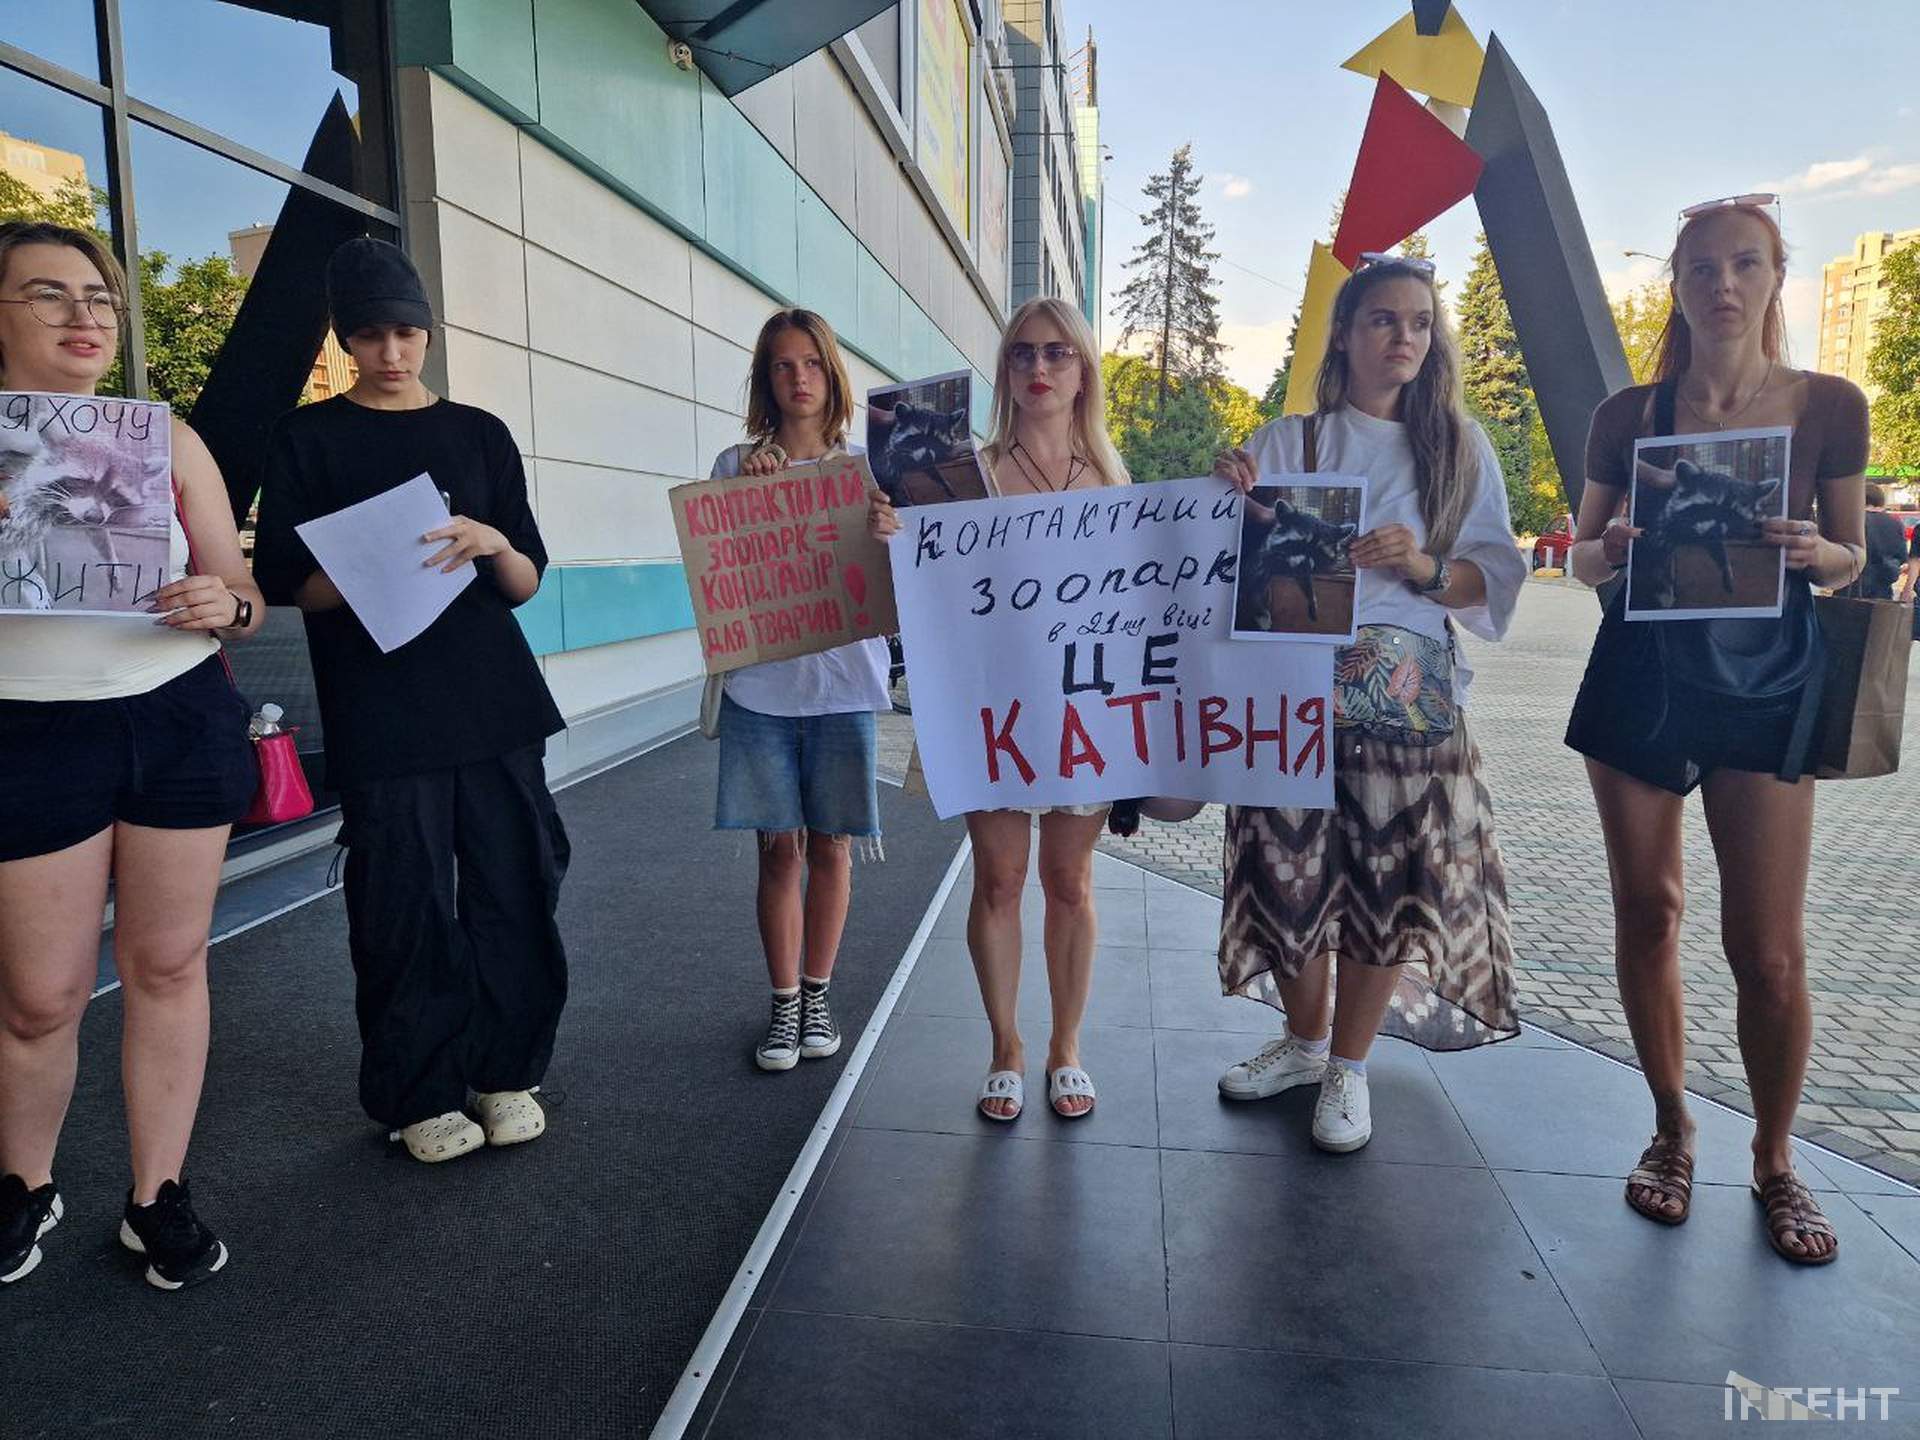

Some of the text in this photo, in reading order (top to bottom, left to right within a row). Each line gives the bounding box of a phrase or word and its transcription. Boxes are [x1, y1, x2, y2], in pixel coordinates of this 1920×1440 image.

[2, 395, 152, 441] Я ХОЧУ
[684, 463, 865, 538] КОНТАКТНИЙ
[914, 490, 1237, 568] КОНТАКТНИЙ
[707, 523, 811, 572] ЗООПАРК
[2, 558, 163, 605] ЖИТИ
[705, 598, 844, 659] ДЛЯ ТВАРИН
[1062, 631, 1180, 696] ЦЕ
[980, 686, 1326, 786] КАТІВНЯ
